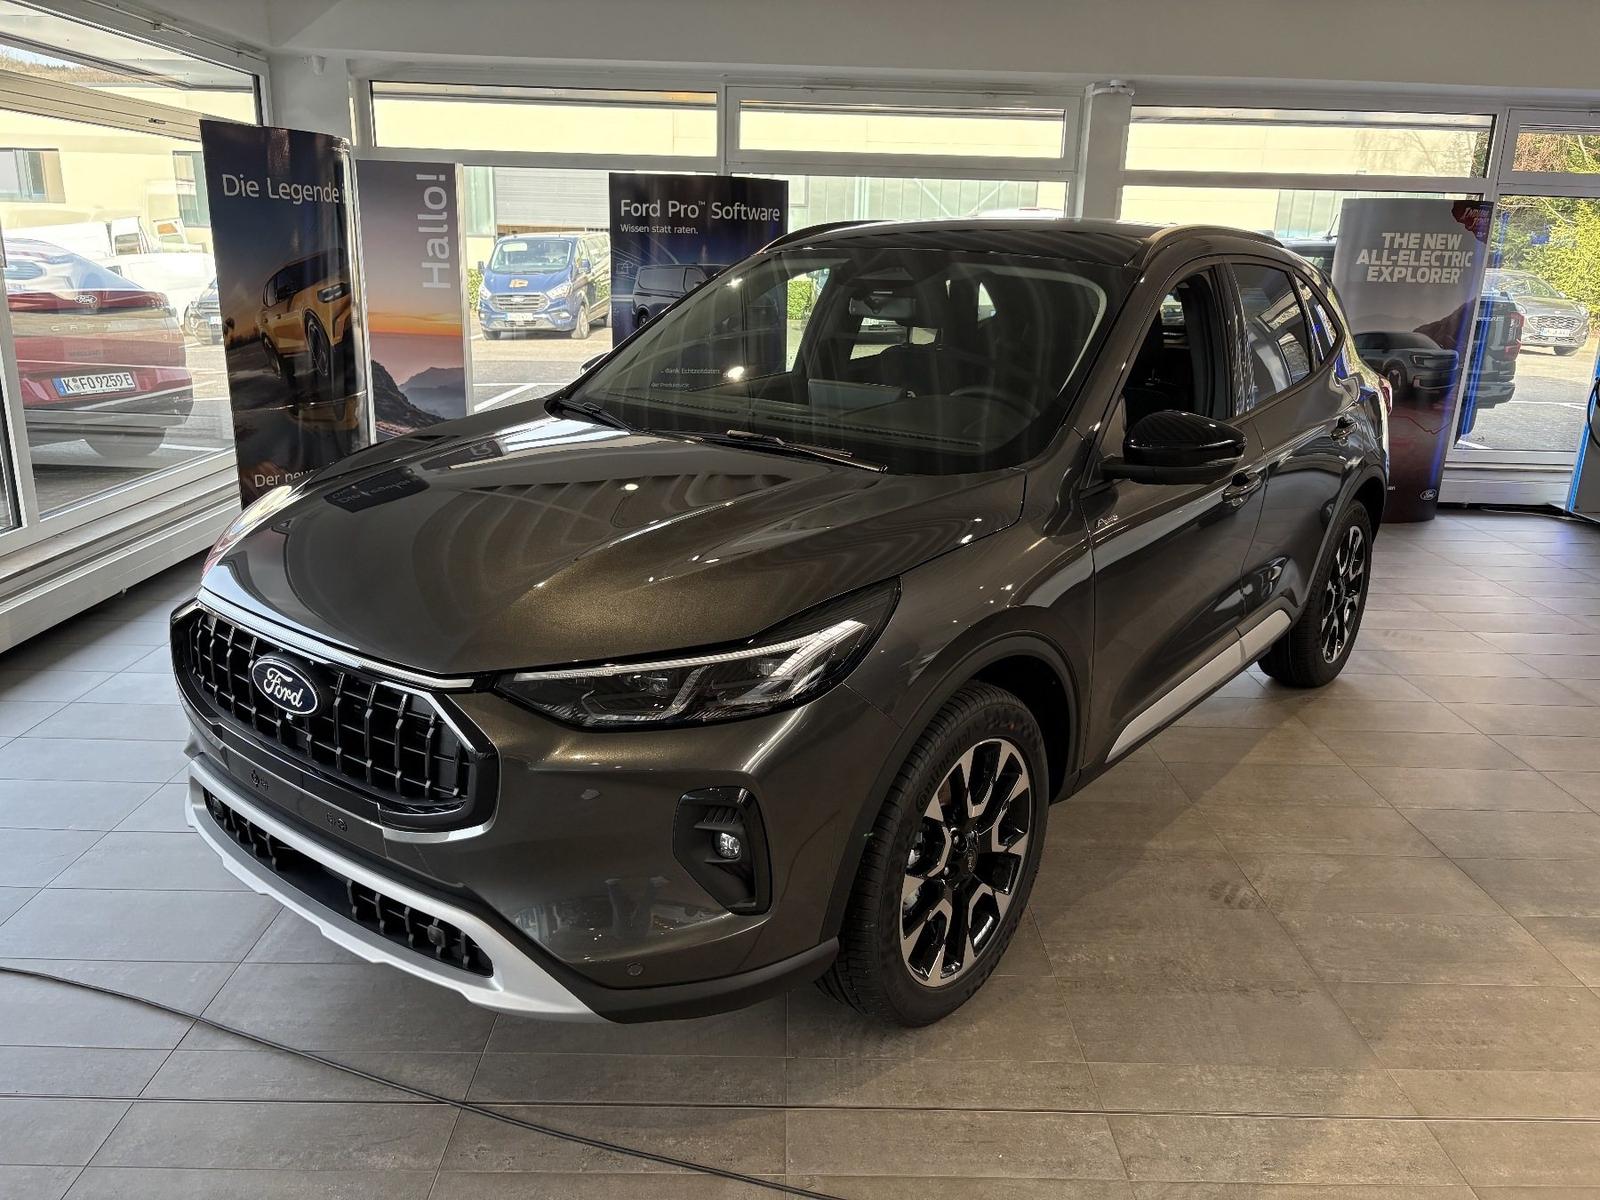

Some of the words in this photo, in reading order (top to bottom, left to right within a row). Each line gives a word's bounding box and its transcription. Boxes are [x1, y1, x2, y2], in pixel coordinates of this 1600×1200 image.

[222, 173, 260, 198] Die
[266, 177, 340, 205] Legende
[620, 199, 661, 217] Ford
[711, 202, 781, 222] Software
[416, 173, 451, 289] Hallo!
[620, 223, 650, 233] Wissen
[651, 224, 672, 234] statt
[673, 226, 699, 235] raten.
[1381, 232, 1421, 249] THE
[1423, 233, 1463, 250] NEW
[1355, 248, 1474, 267] ALL-ELECTRIC
[254, 473, 281, 488] Der
[263, 667, 304, 708] Ford
